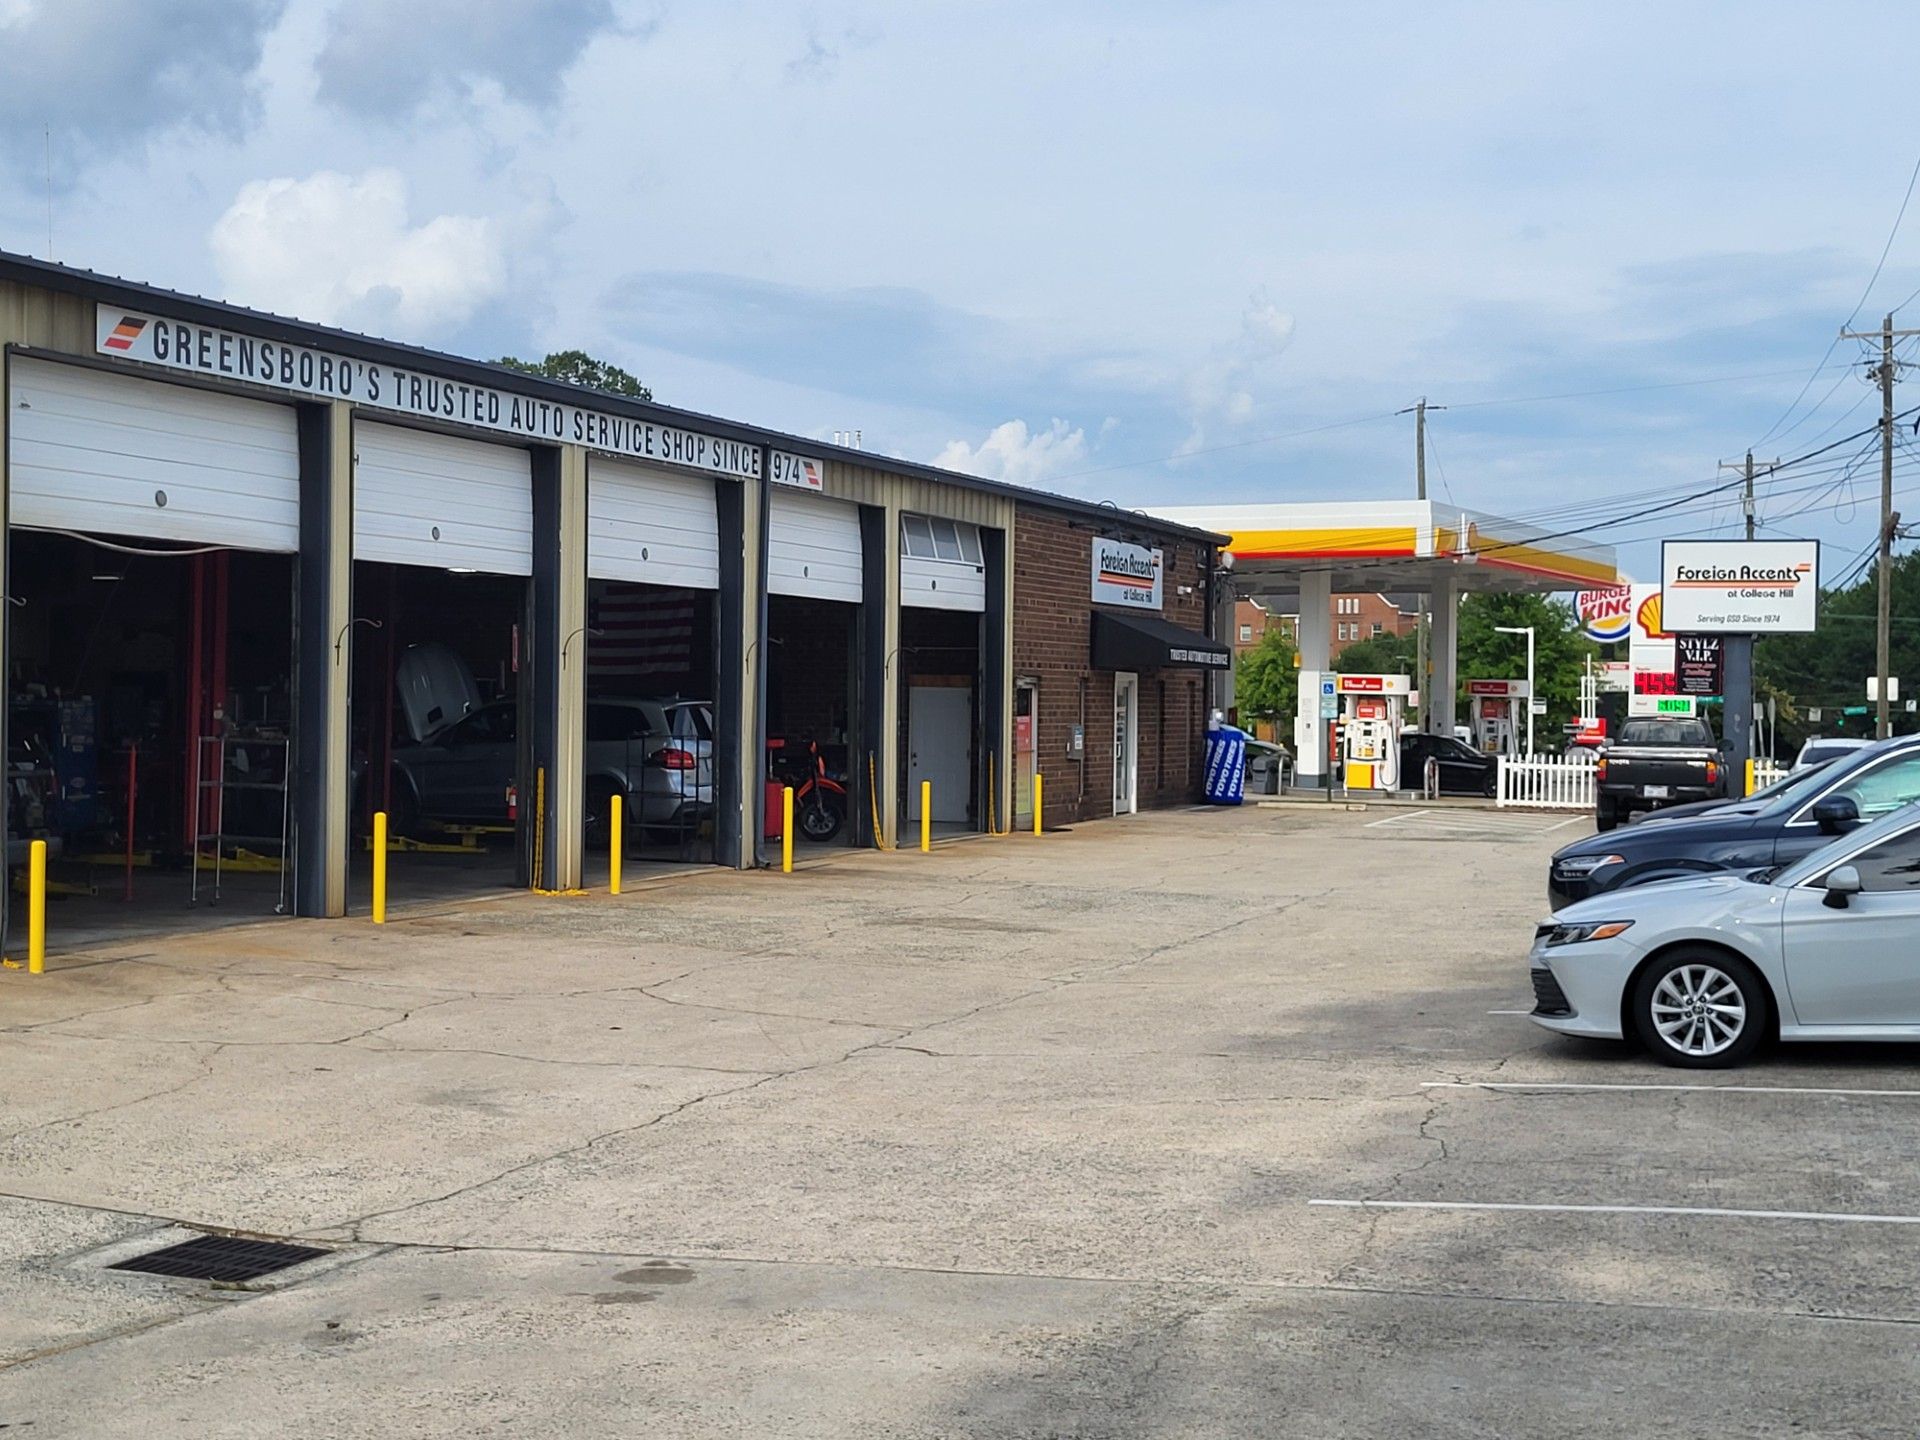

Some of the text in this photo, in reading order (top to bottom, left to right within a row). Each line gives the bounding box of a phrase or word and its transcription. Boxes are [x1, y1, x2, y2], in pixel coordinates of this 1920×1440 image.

[153, 320, 800, 484] GREENSBORO'S TRUSTED AUTO SERVICE SHOP SINCE 974
[1101, 547, 1156, 580] Foreign Accents
[1677, 565, 1801, 582] Foreign Accents
[1727, 589, 1794, 598] at College Hill
[1582, 597, 1631, 621] KING
[1697, 614, 1726, 624] Serving
[1742, 614, 1762, 623] Since
[1764, 614, 1781, 623] 1974
[1680, 638, 1719, 650] STYLZ
[1685, 650, 1712, 661] V.I.P.
[1215, 768, 1229, 797] TOYO
[1228, 768, 1241, 797] TOYO
